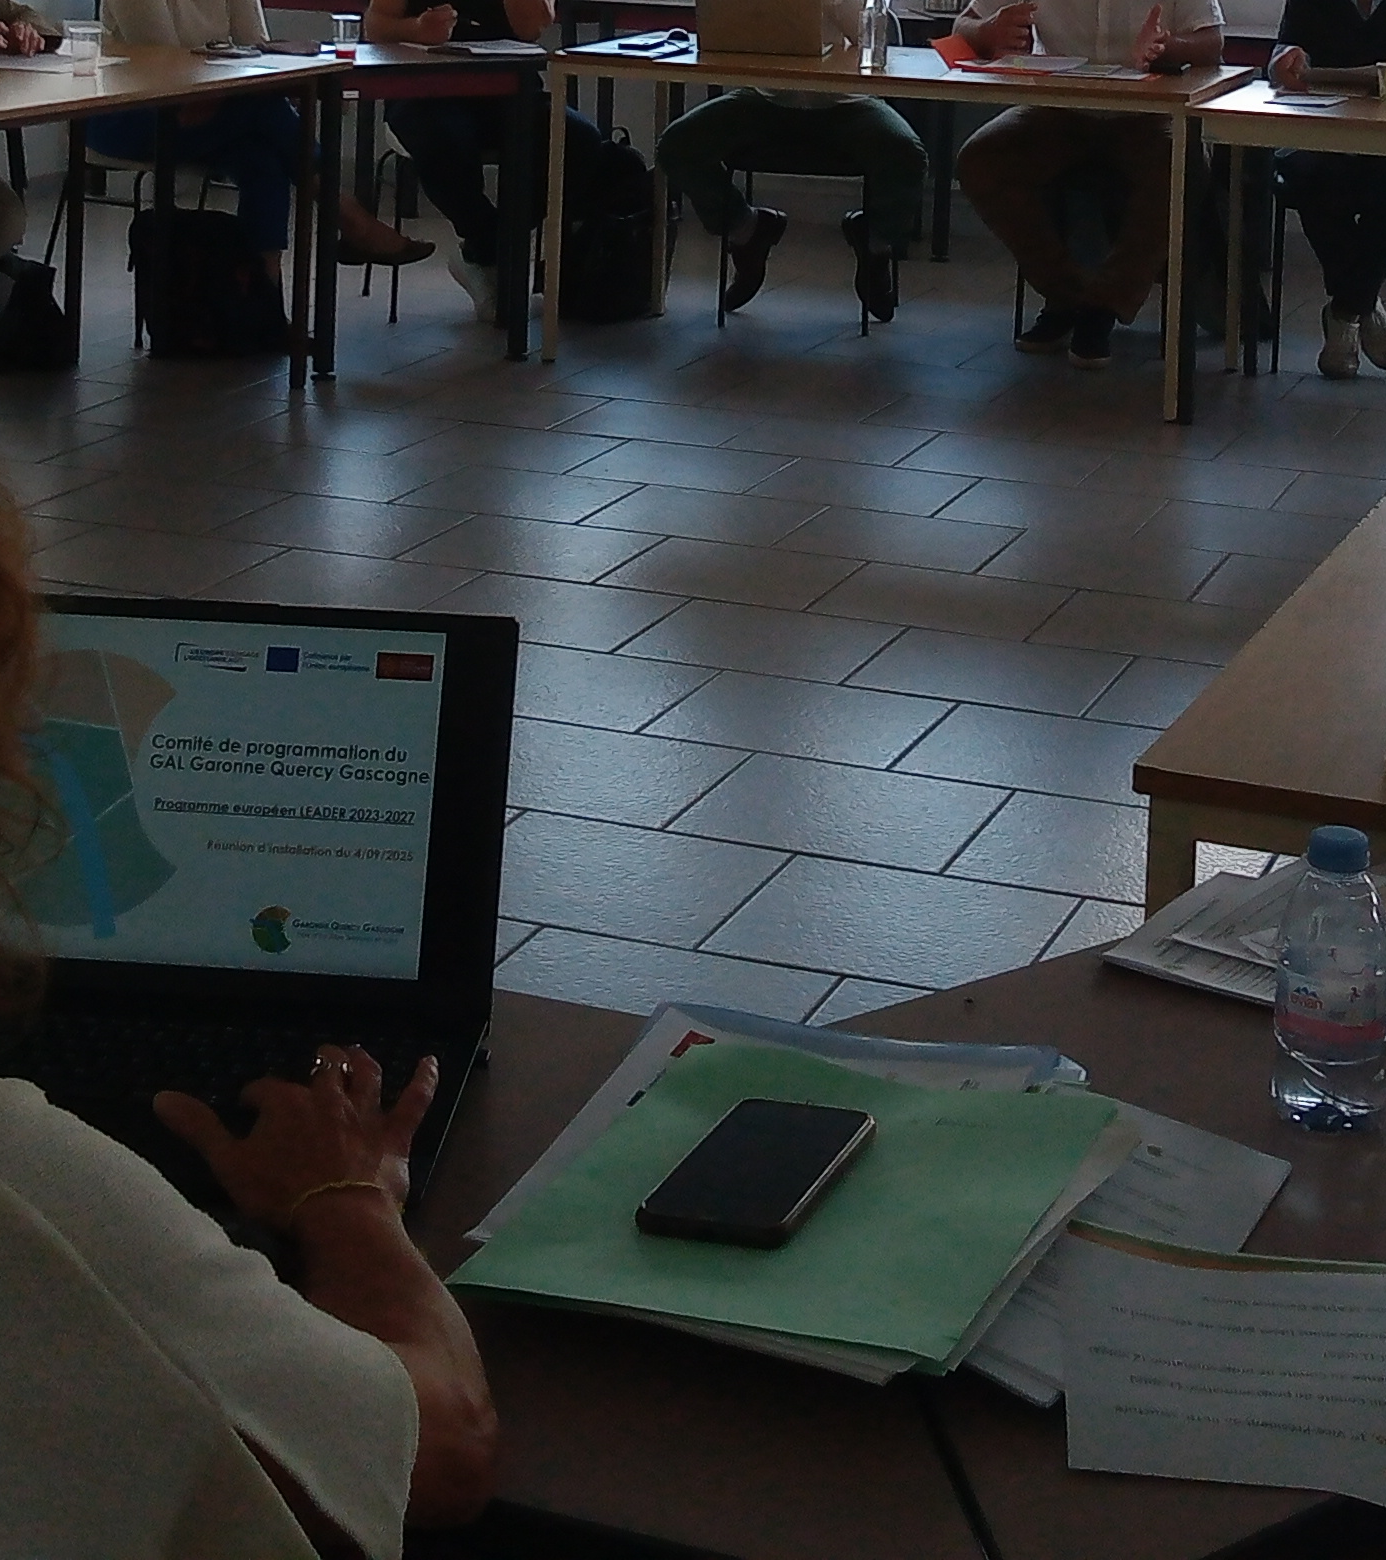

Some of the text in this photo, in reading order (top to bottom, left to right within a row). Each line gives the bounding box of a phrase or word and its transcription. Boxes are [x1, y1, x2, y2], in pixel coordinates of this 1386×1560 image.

[152, 734, 407, 762] Comité de programmation du
[150, 754, 430, 786] GAL Garonne Quercy Gascogne
[153, 797, 415, 825] Programme européen LEADER 2023-2027
[335, 846, 351, 858] du
